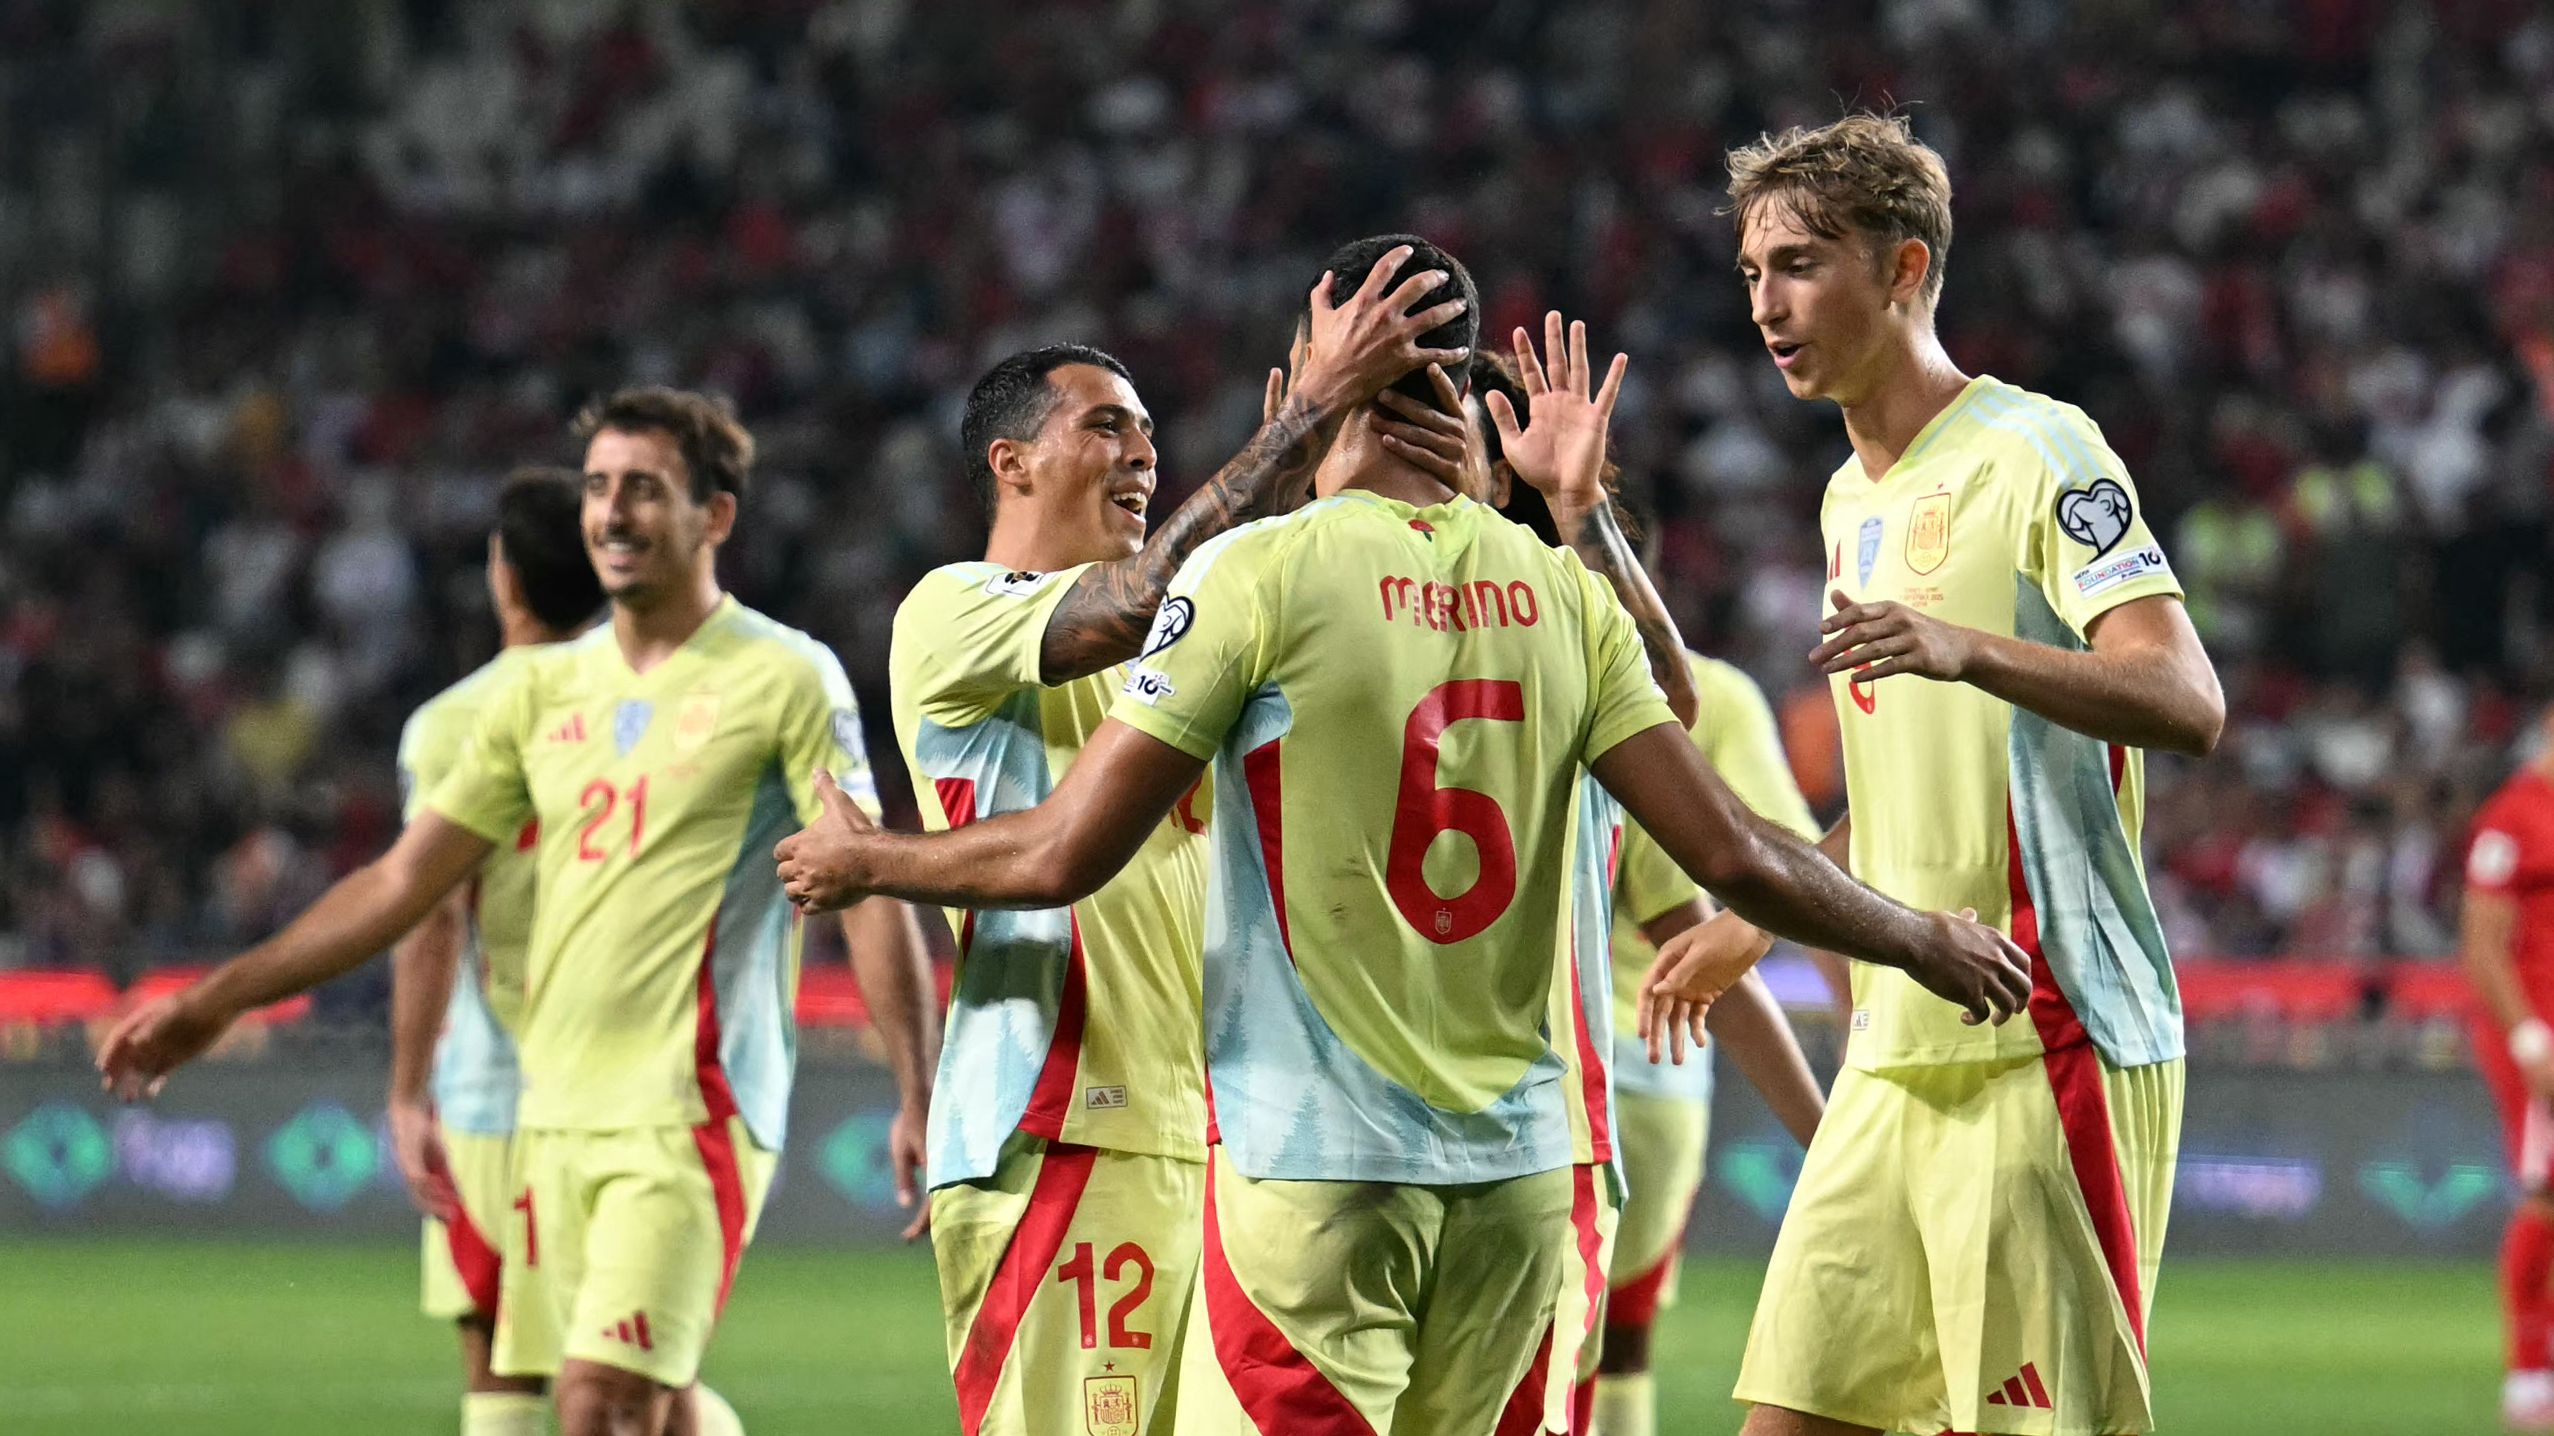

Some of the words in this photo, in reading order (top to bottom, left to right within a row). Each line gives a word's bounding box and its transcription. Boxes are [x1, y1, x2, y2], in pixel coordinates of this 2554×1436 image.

[1379, 574, 1539, 632] MERINO
[2078, 559, 2139, 590] FOUNDATION
[579, 774, 648, 861] 21
[1386, 678, 1525, 945] 6
[1057, 1241, 1155, 1350] 12
